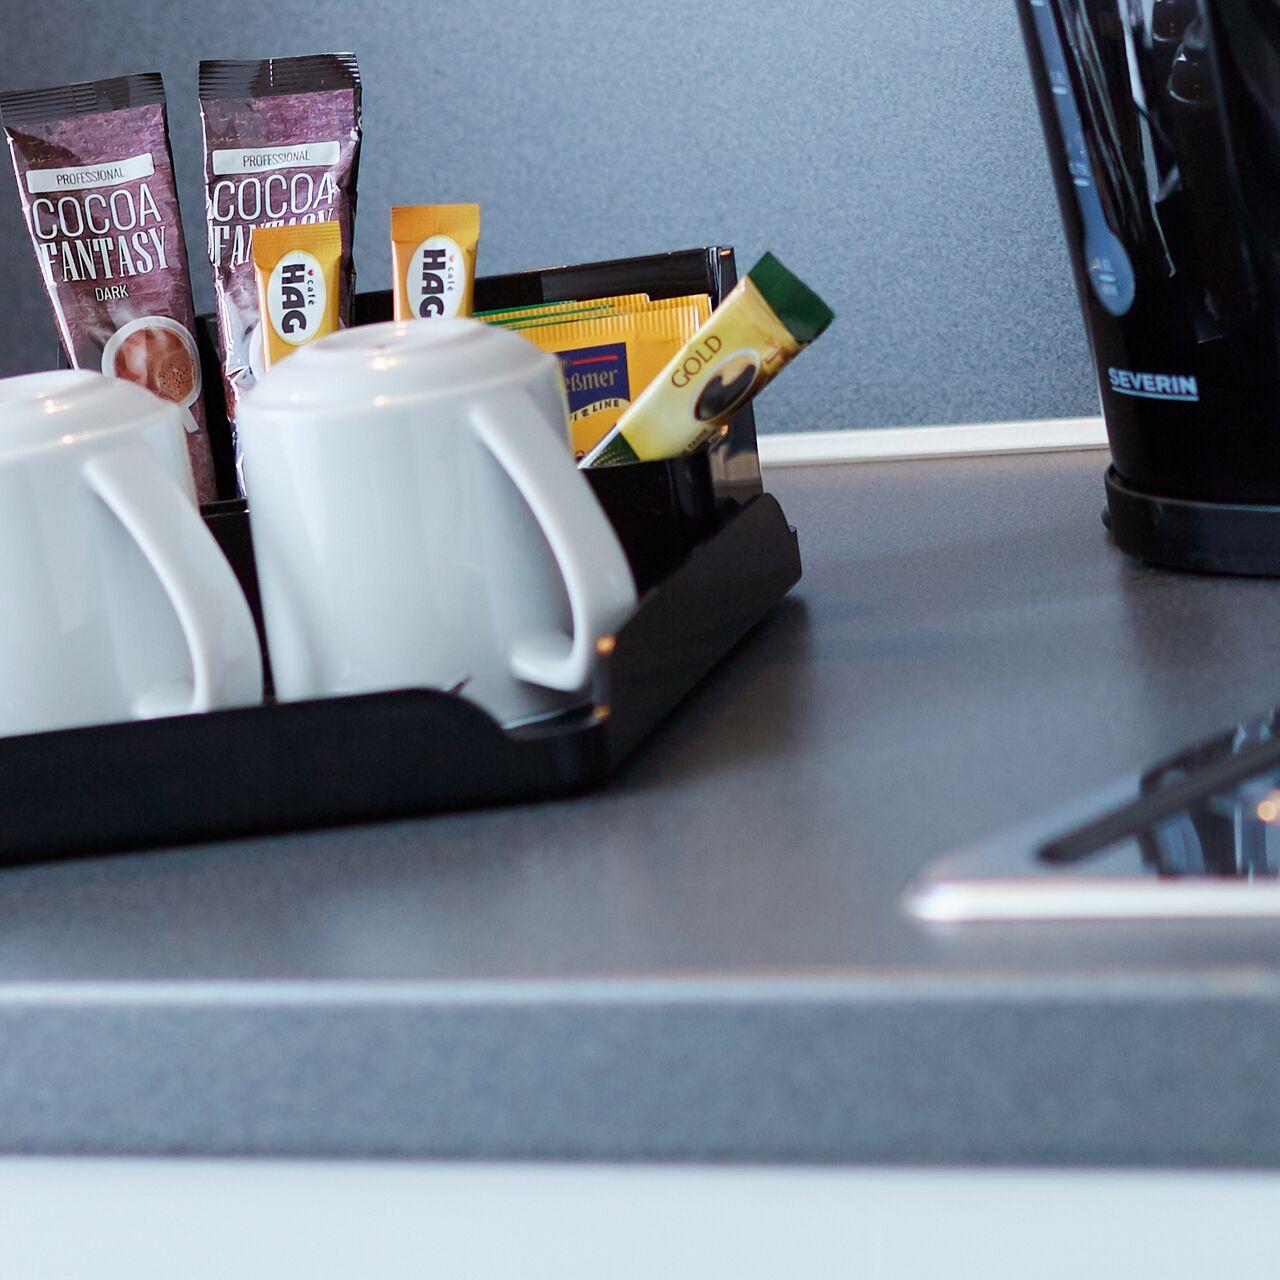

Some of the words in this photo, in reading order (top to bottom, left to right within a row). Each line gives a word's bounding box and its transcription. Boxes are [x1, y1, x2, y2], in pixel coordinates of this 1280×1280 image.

[56, 167, 124, 185] PROFESSIONAL
[242, 150, 310, 168] PROFESSIONAL
[32, 183, 162, 240] COCOA
[213, 171, 335, 222] COCOA
[39, 225, 169, 283] FANTASY
[95, 285, 130, 302] DARK
[281, 263, 307, 334] HAG
[419, 249, 446, 318] HAG
[671, 335, 722, 388] GOLD
[1108, 367, 1198, 395] SEVERIN
